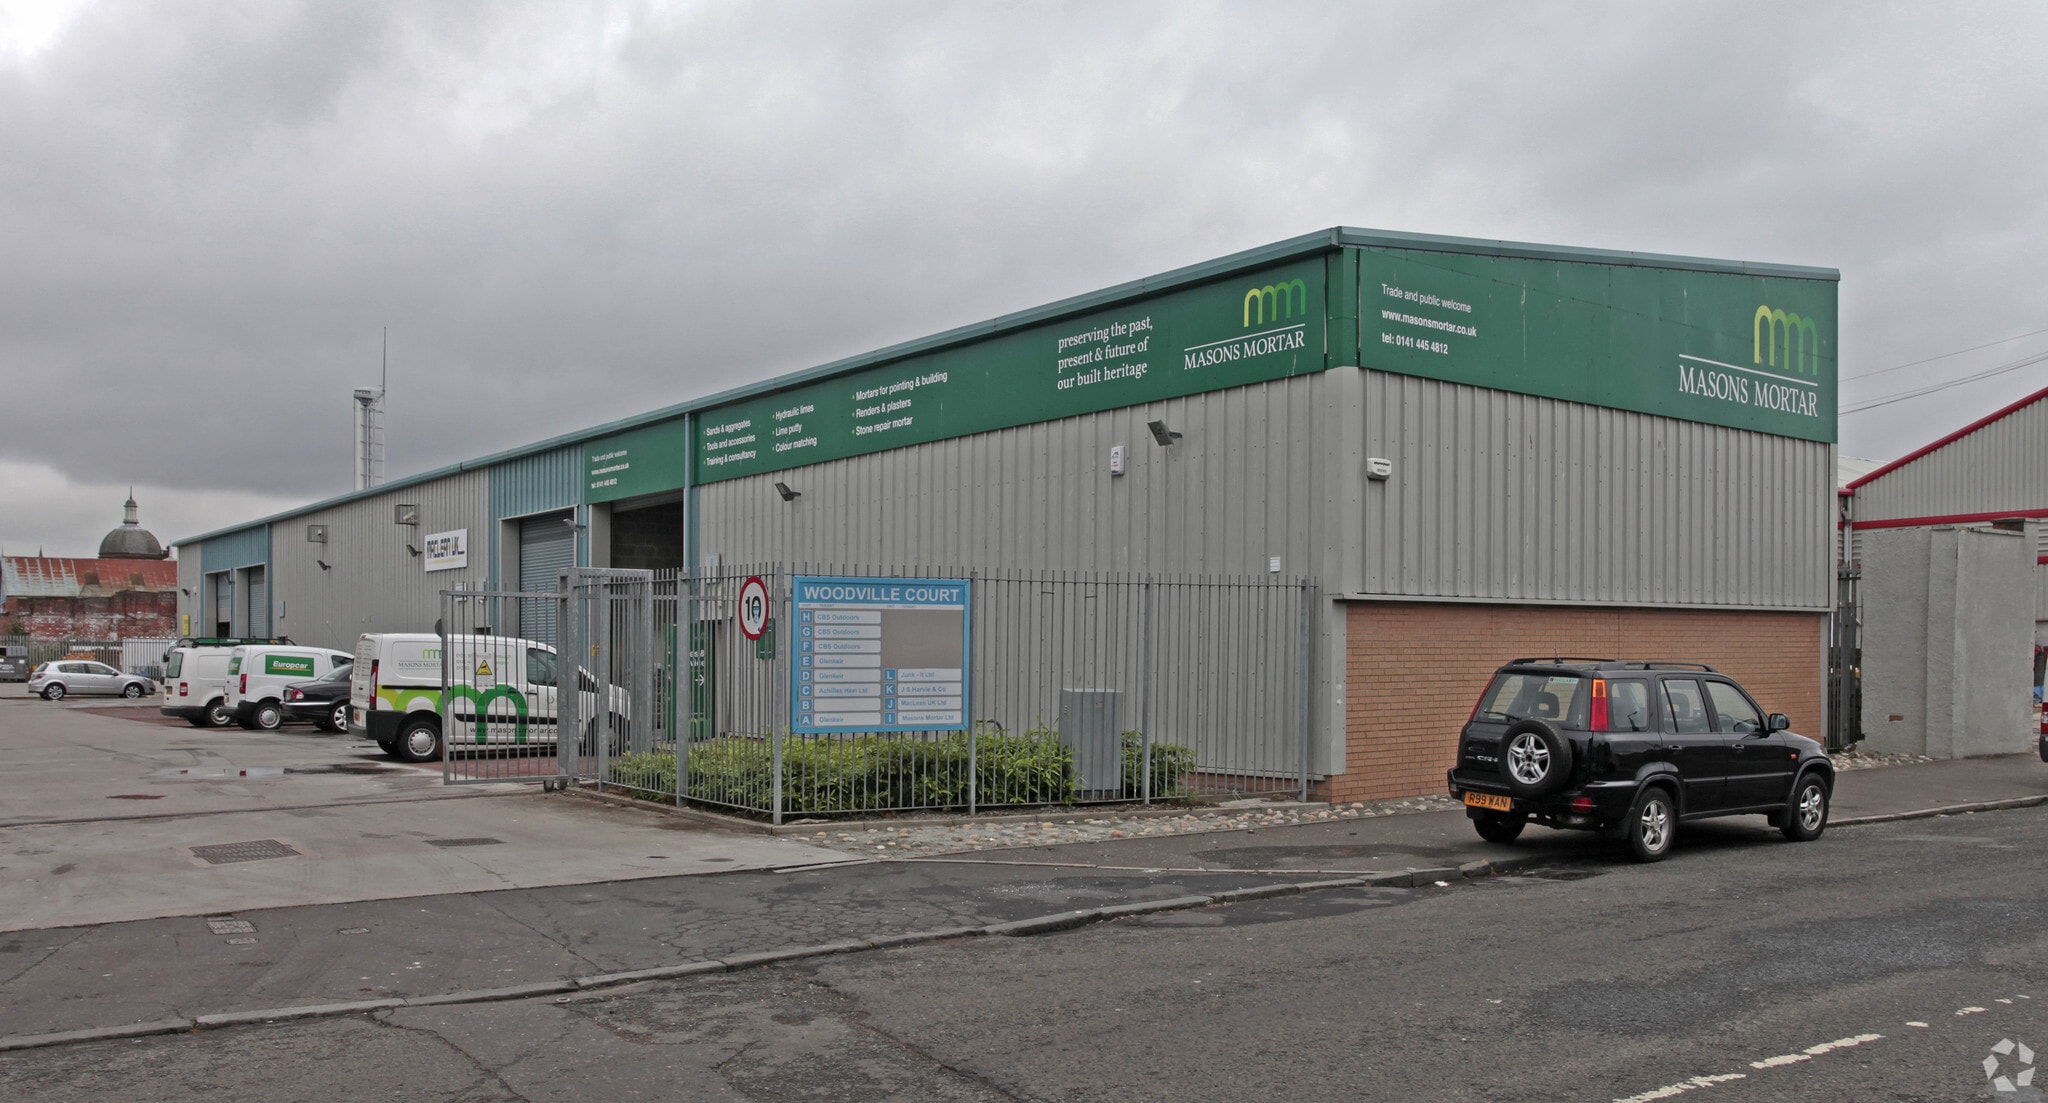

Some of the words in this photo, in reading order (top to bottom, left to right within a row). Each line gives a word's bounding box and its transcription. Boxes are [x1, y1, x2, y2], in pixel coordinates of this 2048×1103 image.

[1381, 283, 1403, 298] Trade
[1404, 291, 1418, 302] and
[1419, 293, 1440, 306] public
[1442, 298, 1472, 313] welcome
[1381, 310, 1477, 337] www.masonsmortar.co.uk
[1058, 326, 1109, 353] preserving
[1111, 321, 1127, 337] the
[1129, 316, 1153, 337] past,
[1184, 344, 1240, 370] MASONS
[1243, 330, 1305, 358] MORTAR
[1381, 332, 1394, 344] tel:
[1396, 335, 1414, 348] 0141
[1416, 339, 1429, 351] 445
[1430, 342, 1448, 354] 4812
[1058, 350, 1093, 373] present
[1094, 347, 1103, 361] &
[1105, 344, 1136, 359] future
[1137, 336, 1149, 352] of
[1057, 377, 1075, 390] our
[1077, 368, 1101, 386] built
[1104, 362, 1148, 379] heritage
[856, 388, 878, 400] Mortars
[879, 386, 888, 395] for
[889, 380, 914, 395] pointing
[915, 376, 920, 387] &
[921, 372, 948, 385] building
[1679, 365, 1749, 404] MASONS
[1754, 381, 1818, 417] MORTAR
[775, 407, 799, 421] Hydraulic
[800, 404, 814, 414] limes
[856, 406, 880, 418] Renders
[881, 403, 886, 412] &
[887, 399, 911, 413] plasters
[706, 426, 720, 436] Sands
[721, 424, 725, 433] &
[725, 419, 751, 433] aggregates
[775, 427, 788, 436] Lime
[789, 423, 802, 435] putty
[856, 425, 873, 435] Stone
[874, 420, 891, 432] repair
[892, 417, 913, 428] mortar
[706, 441, 718, 450] Tools
[719, 438, 728, 448] and
[728, 434, 755, 446] accessories
[775, 442, 792, 452] Colour
[793, 436, 817, 448] matching
[706, 456, 723, 466] Training
[724, 453, 728, 463] &
[728, 450, 756, 462] consultancy
[804, 586, 900, 601] WOODVILLE
[905, 588, 960, 602] COURT
[803, 612, 810, 621] H
[802, 627, 811, 636] G
[803, 642, 809, 651] F
[272, 660, 308, 670] Europcar
[803, 657, 809, 666] E
[802, 671, 810, 680] D
[886, 671, 893, 680] L
[802, 686, 810, 695] C
[886, 685, 893, 694] K
[803, 701, 810, 710] B
[887, 700, 893, 709] J
[802, 716, 810, 725] A
[888, 714, 892, 723] I
[1469, 792, 1486, 805] R99
